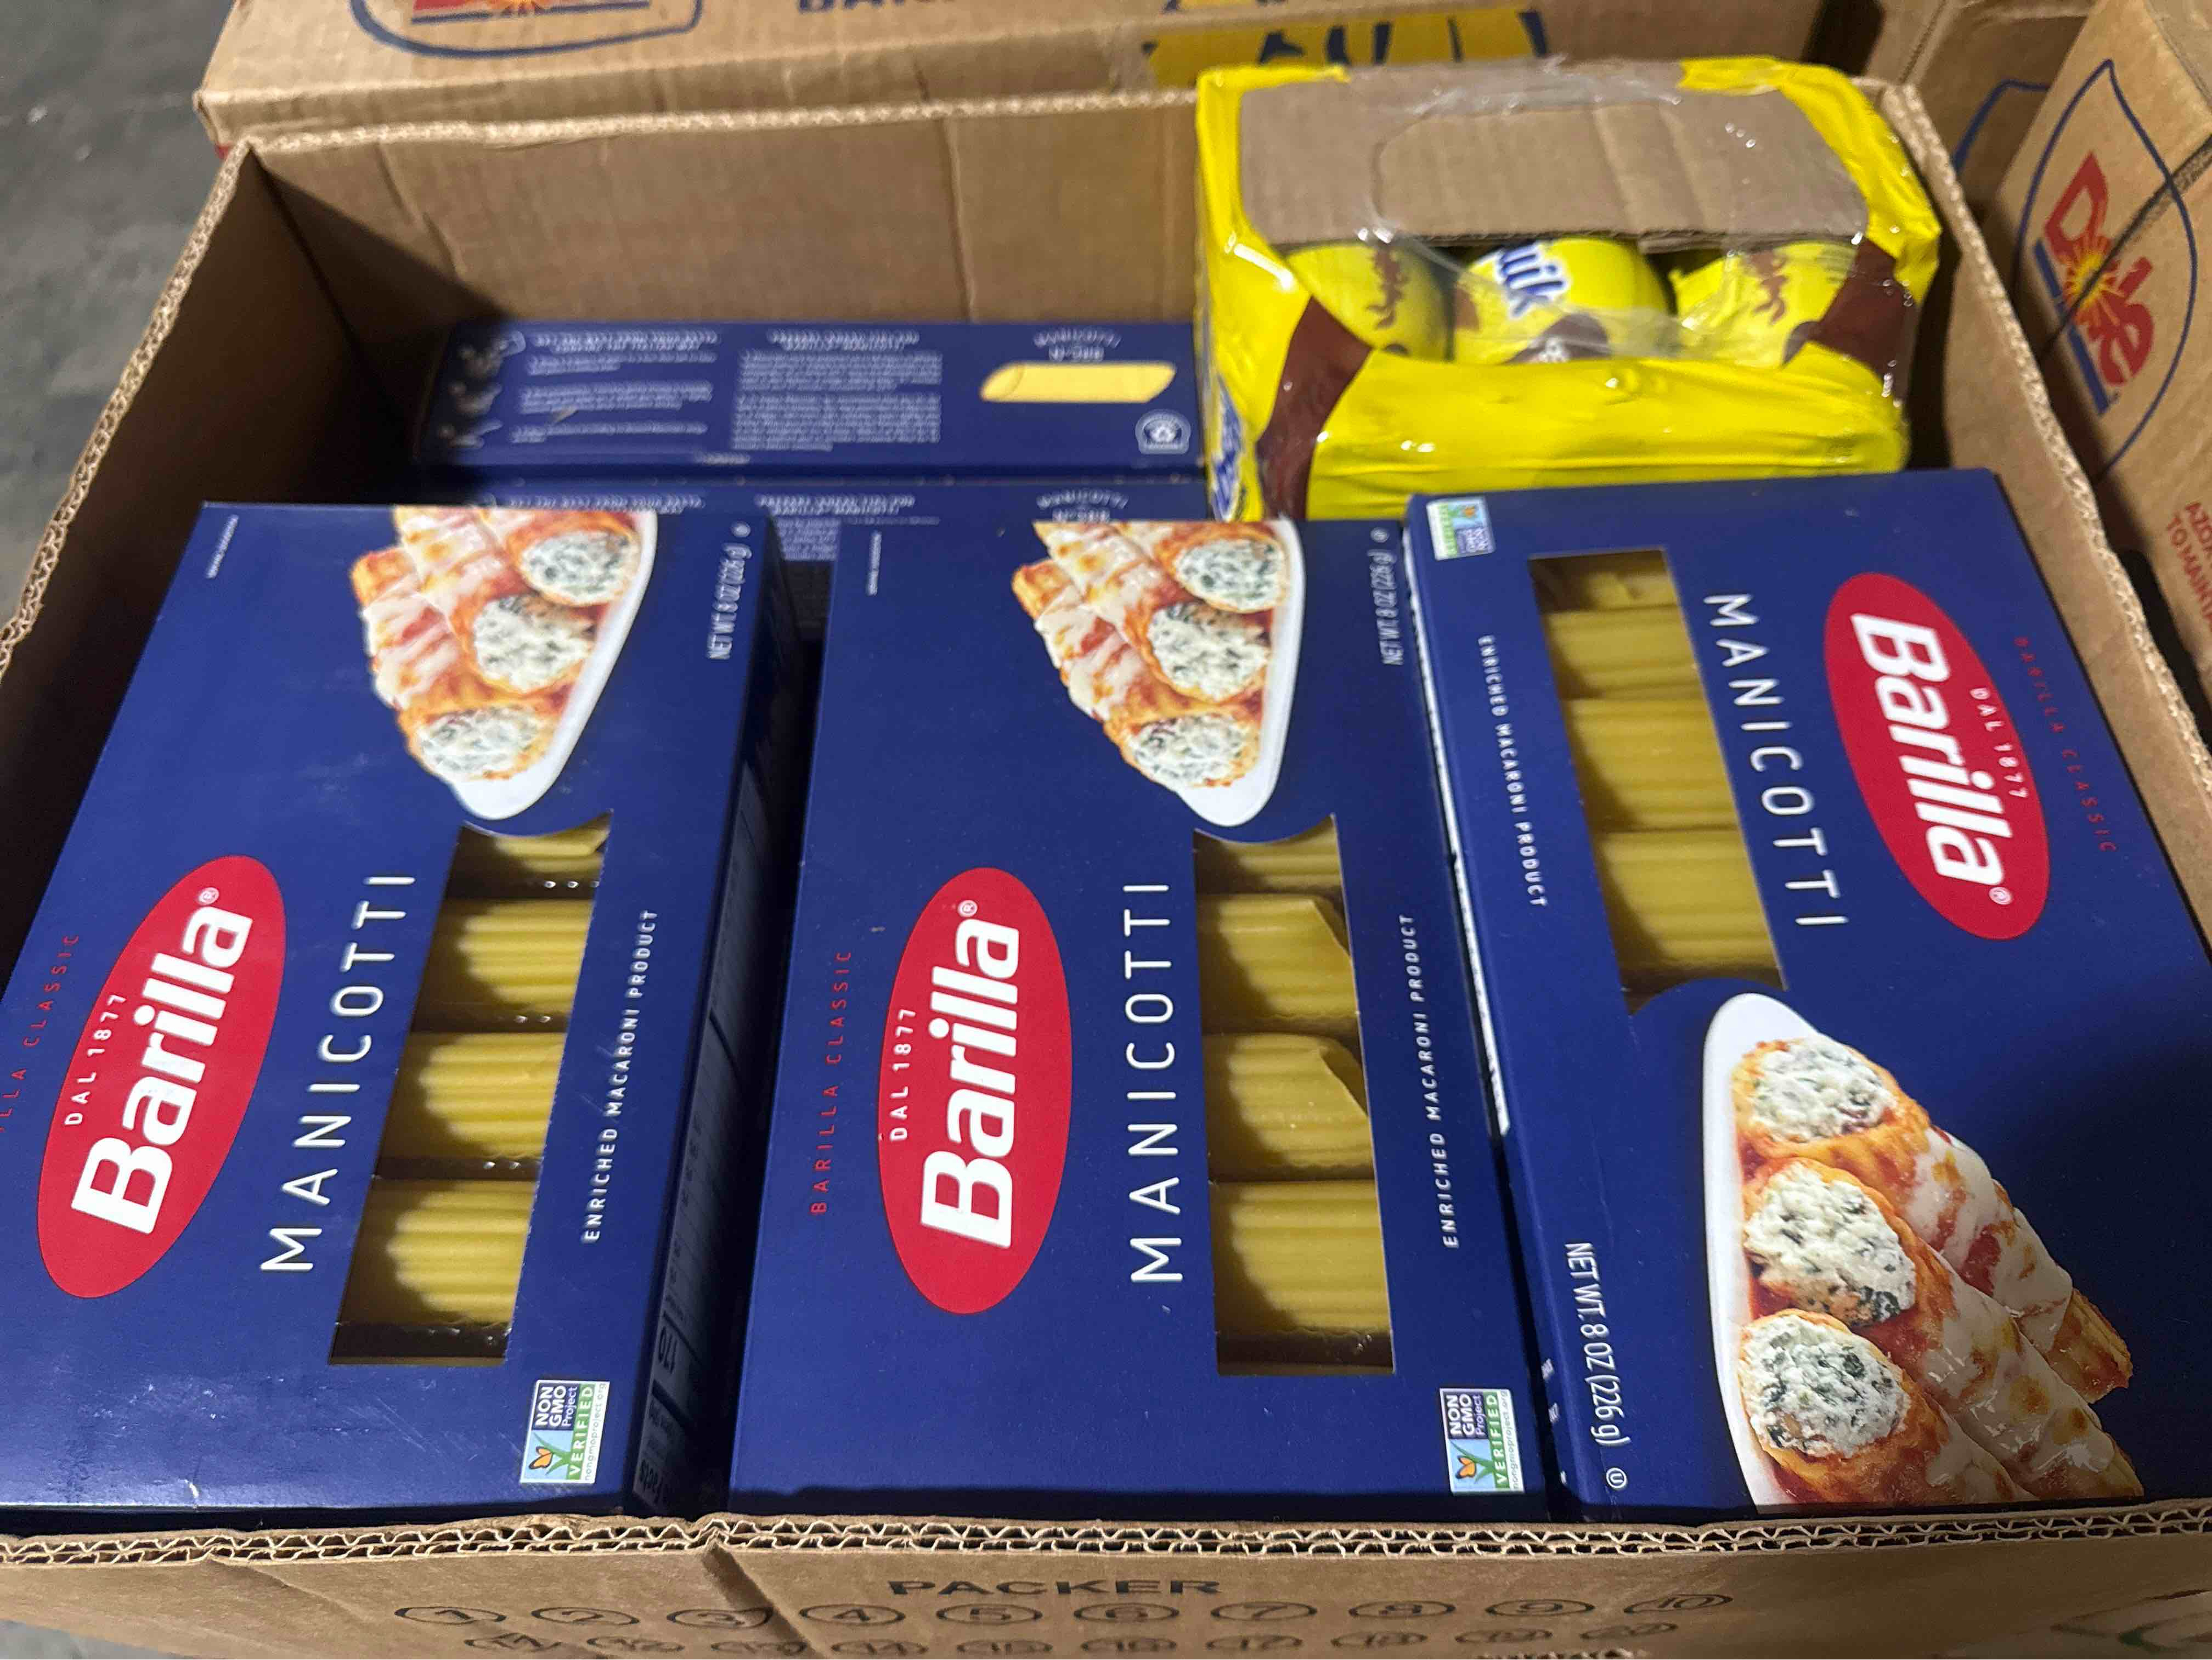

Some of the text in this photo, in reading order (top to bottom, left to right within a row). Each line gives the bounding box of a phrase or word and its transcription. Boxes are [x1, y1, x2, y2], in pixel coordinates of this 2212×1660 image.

[707, 633, 733, 659] NET
[1478, 635, 1548, 908] ENRICHED MACARONI PRODUCT
[1703, 593, 1849, 926] MANICOTTI
[1970, 686, 2029, 800] DAL 1877
[2062, 748, 2117, 852] CLASSIC
[24, 934, 79, 1048] CLASSIC
[64, 994, 126, 1127] DAL 1877
[261, 876, 415, 1271] MANICOTTI
[582, 910, 658, 1243] ENRICHED MACARONI PRODUCT
[810, 952, 851, 1216] BARILLA CLASSIC
[890, 1008, 916, 1142] DAL 1877
[1123, 885, 1183, 1282] MANICOTTI
[1399, 914, 1459, 1248] ENRICHED MACARONI PRODUCT
[1565, 1242, 1601, 1282] NET
[1573, 1283, 1606, 1321] WT.
[1580, 1324, 1610, 1339] 8
[1584, 1343, 1616, 1372] OZ
[535, 1386, 554, 1426] NON
[549, 1385, 567, 1427] GMO
[562, 1386, 578, 1427] Project
[569, 1386, 594, 1476] VERIFIED
[1446, 1394, 1463, 1437] NON
[1459, 1393, 1475, 1437] GMO
[1473, 1394, 1488, 1436] Project
[1485, 1394, 1509, 1485] VERIFIED
[1584, 1374, 1625, 1419] (226
[889, 1580, 1221, 1595] PACKER
